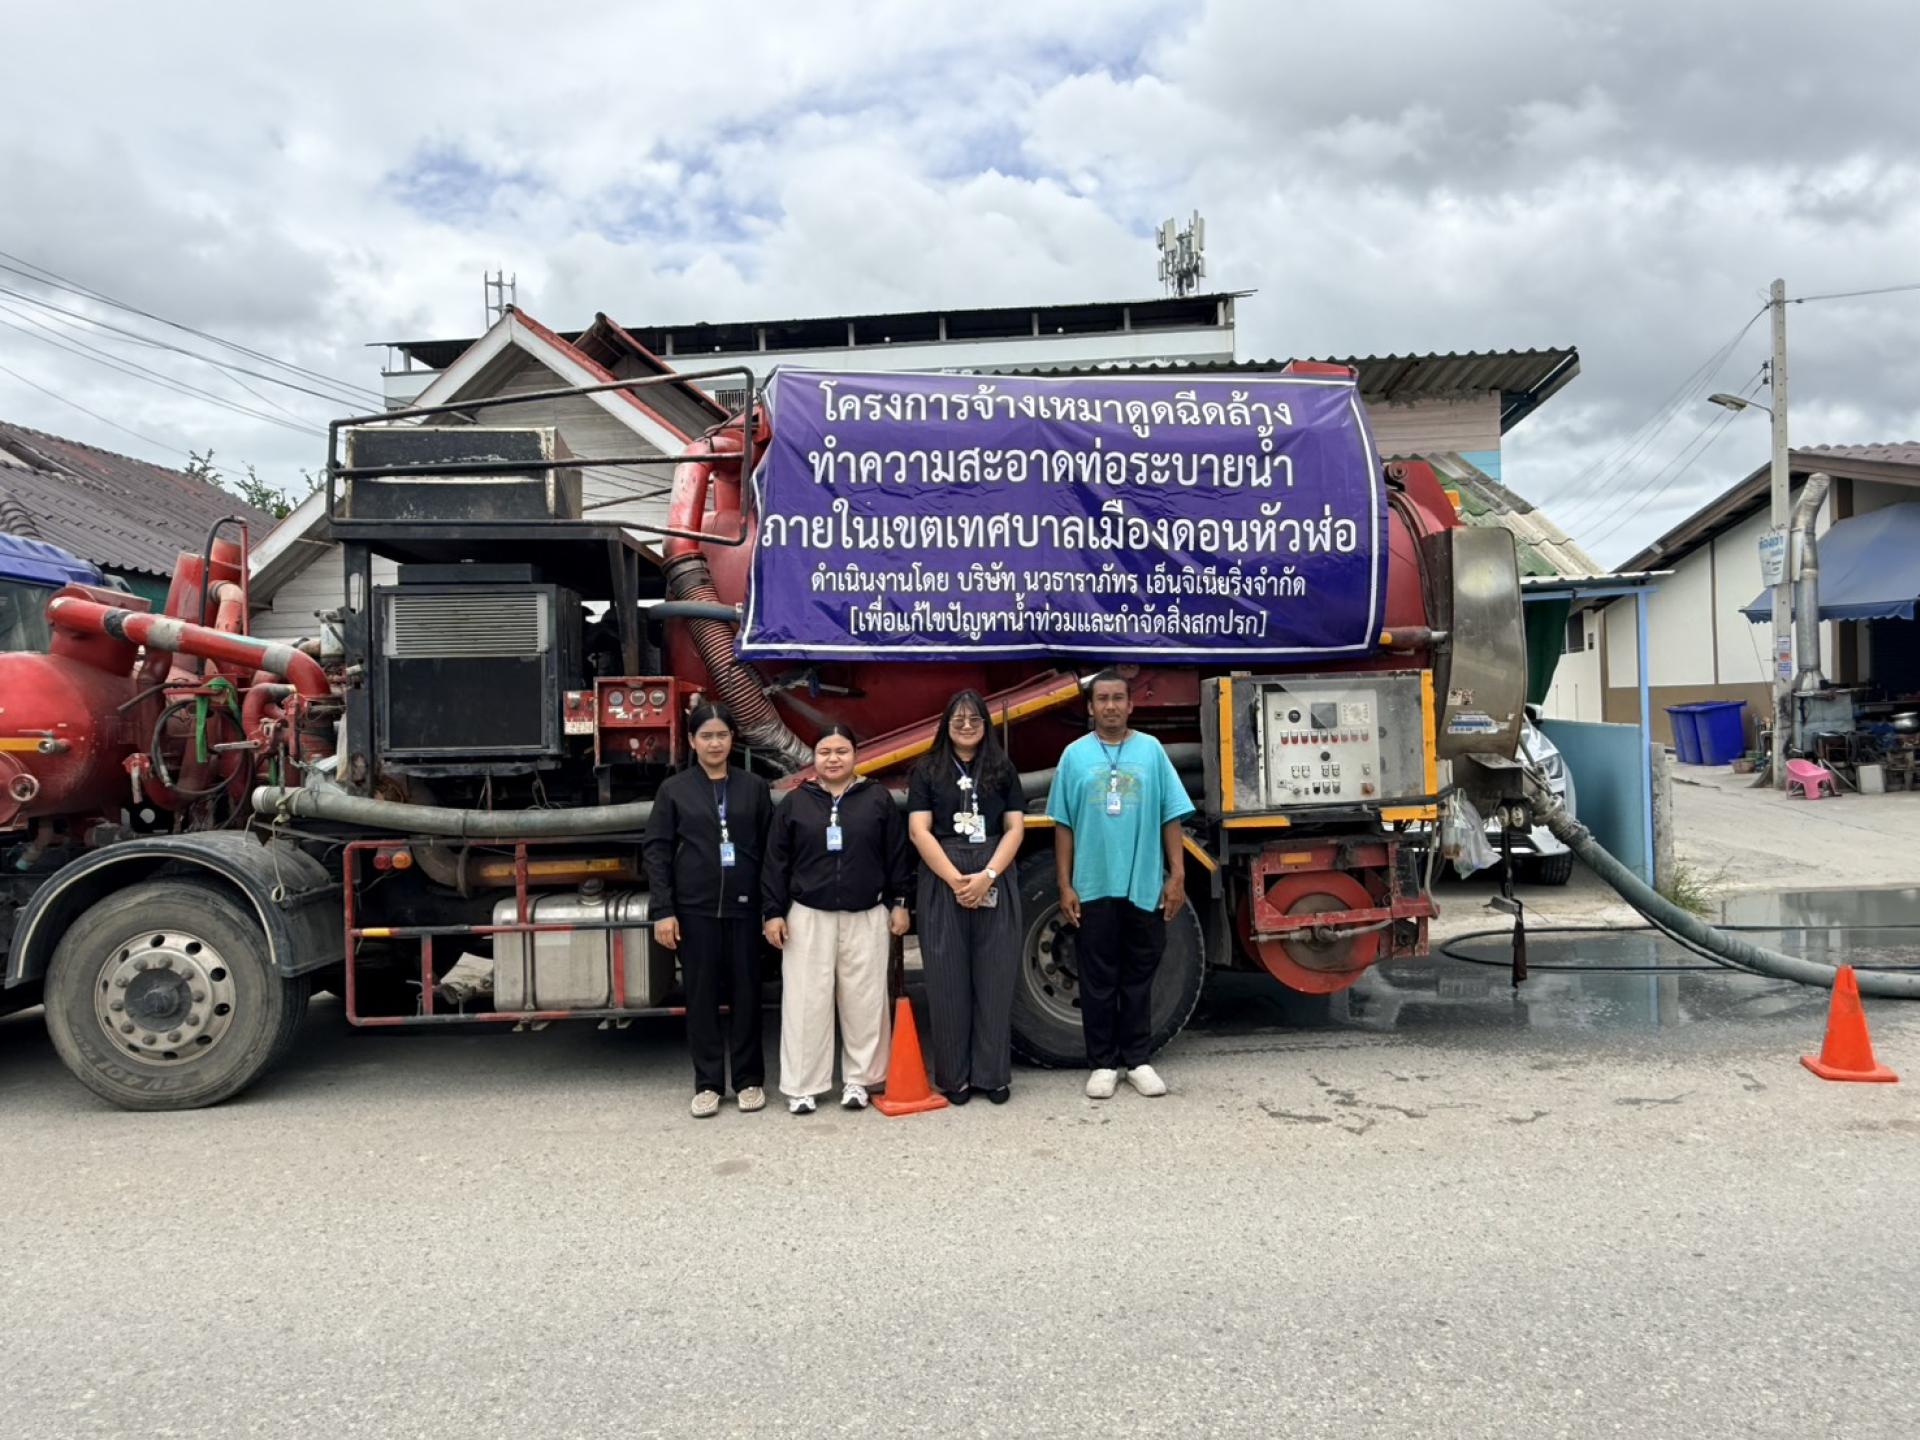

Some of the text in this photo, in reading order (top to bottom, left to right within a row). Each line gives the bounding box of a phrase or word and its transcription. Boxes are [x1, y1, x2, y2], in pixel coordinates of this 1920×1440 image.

[818, 379, 1293, 438] โครงการจ้างเหมาดูดฉีดล้าง
[807, 424, 1294, 488] ทำความสะอาดท่อระบายน้ำ
[760, 497, 1358, 552] ภายในเขตเทศบาลเมืองดอนหัวฬ่อ
[811, 561, 950, 592] ดำเนินงานโดย
[957, 561, 1017, 592] บริษัท
[1023, 565, 1138, 594] นวธาราภัทร
